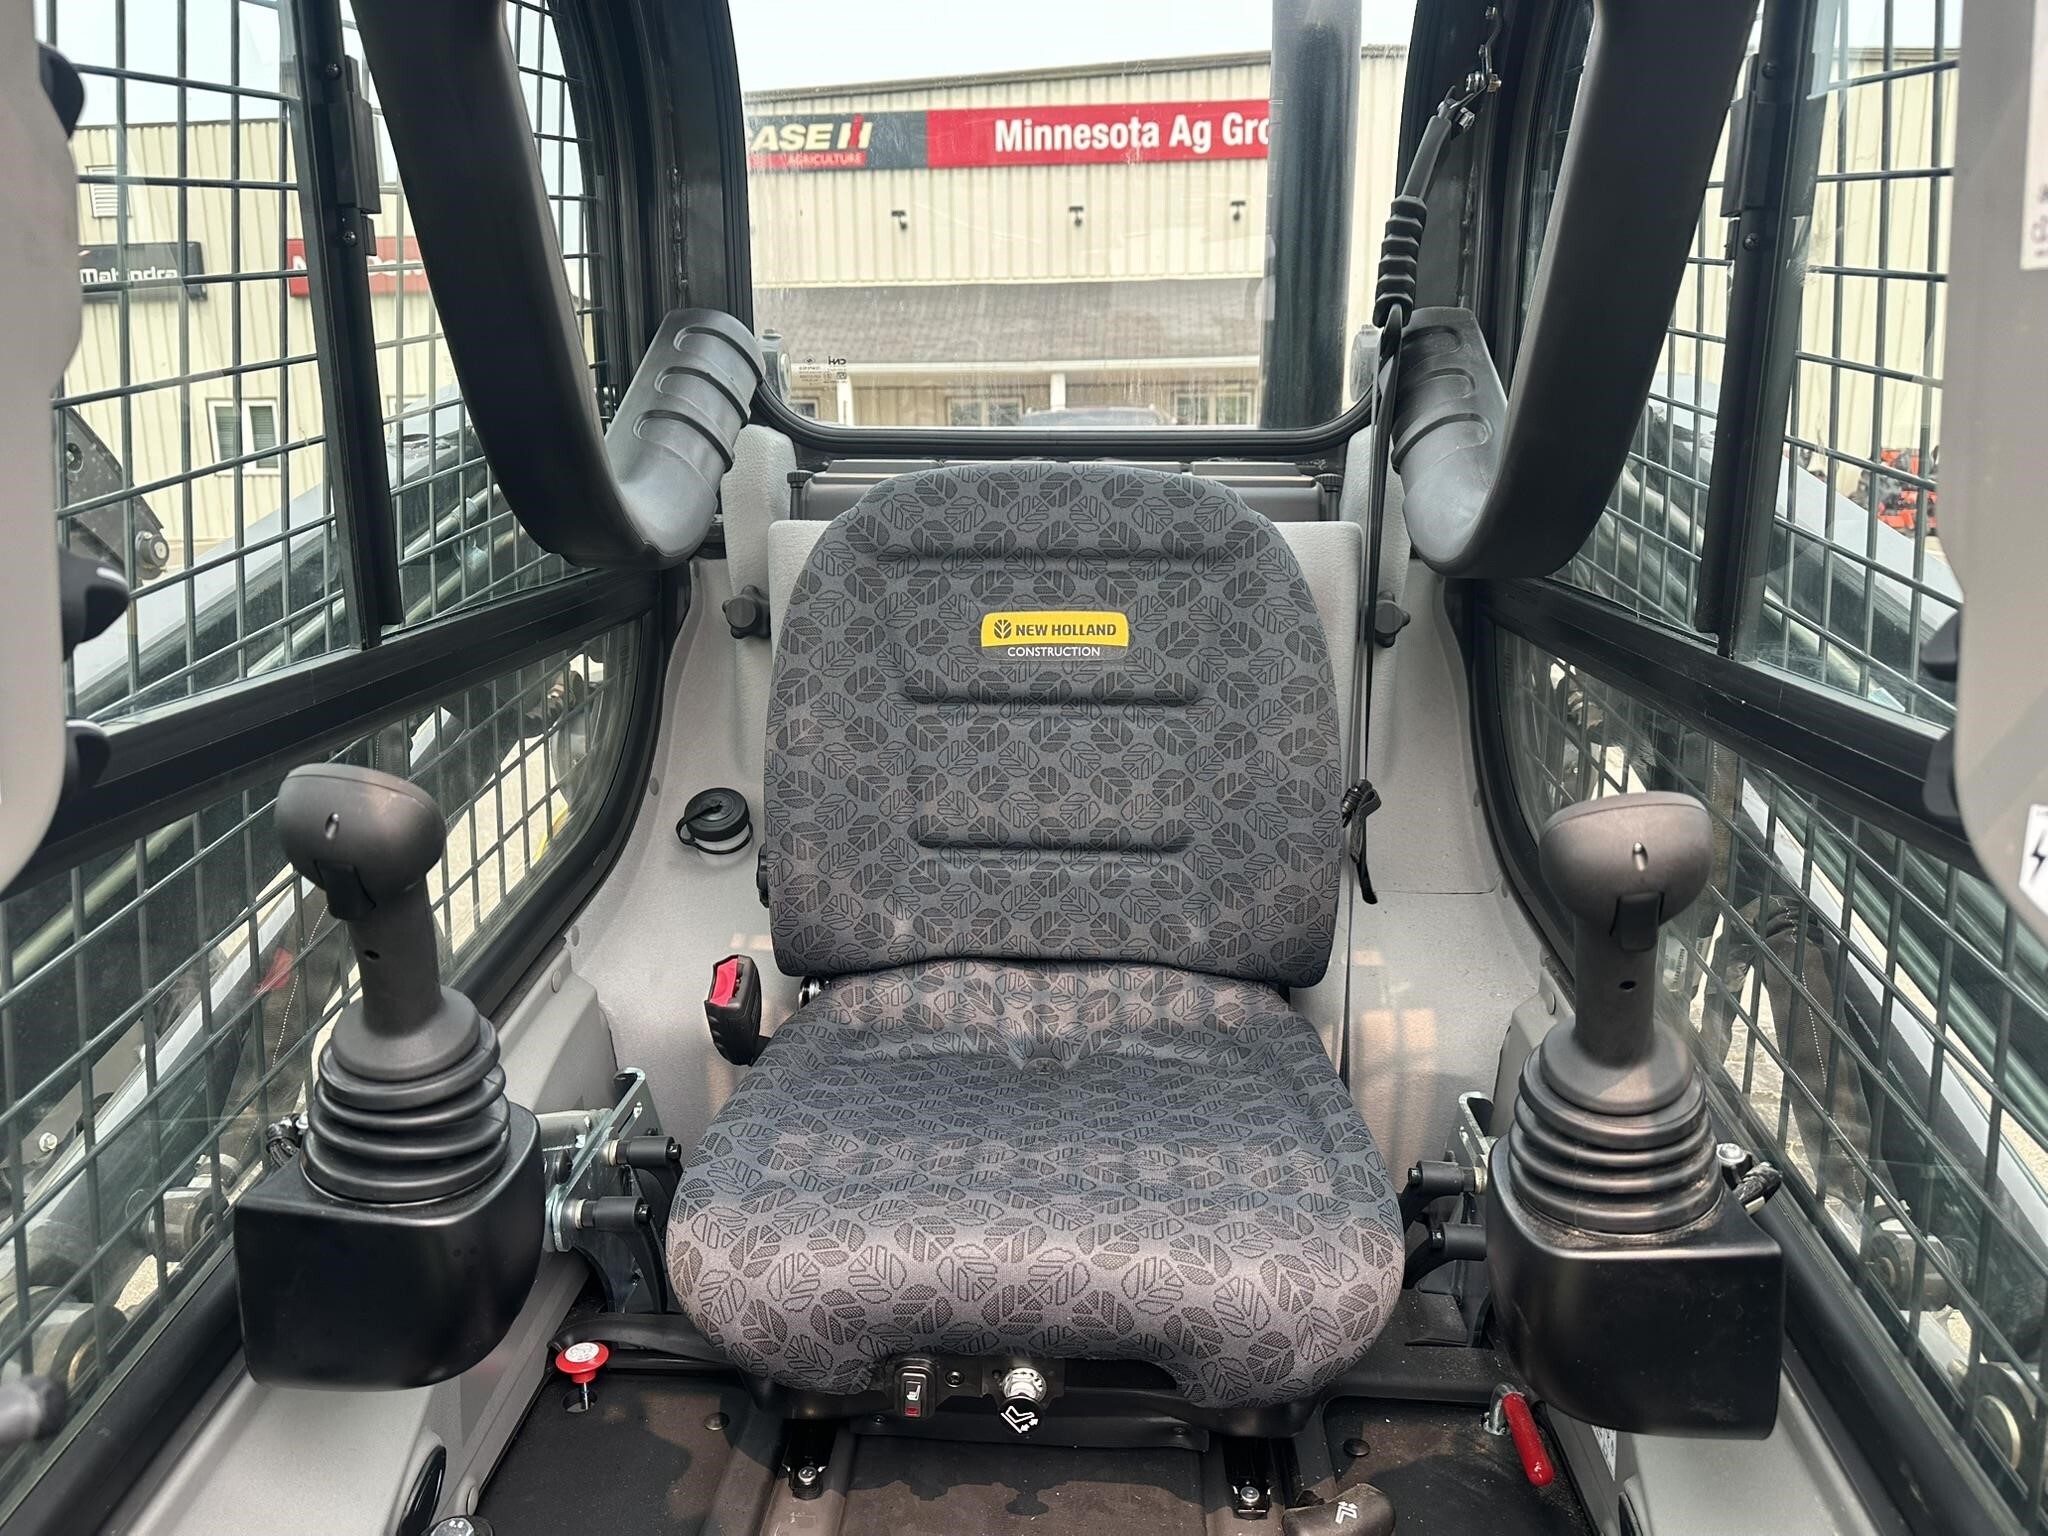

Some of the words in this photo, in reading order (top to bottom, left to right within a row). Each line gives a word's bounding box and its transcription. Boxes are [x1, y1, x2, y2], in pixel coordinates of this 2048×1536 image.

[748, 122, 834, 151] ASE
[994, 117, 1159, 151] Minnesota
[1168, 114, 1212, 153] Ag
[786, 152, 862, 166] AGRICULTURE
[1015, 624, 1047, 636] NEW
[1051, 624, 1117, 636] HOLLAND
[1007, 646, 1101, 657] CONSTRUCTION
